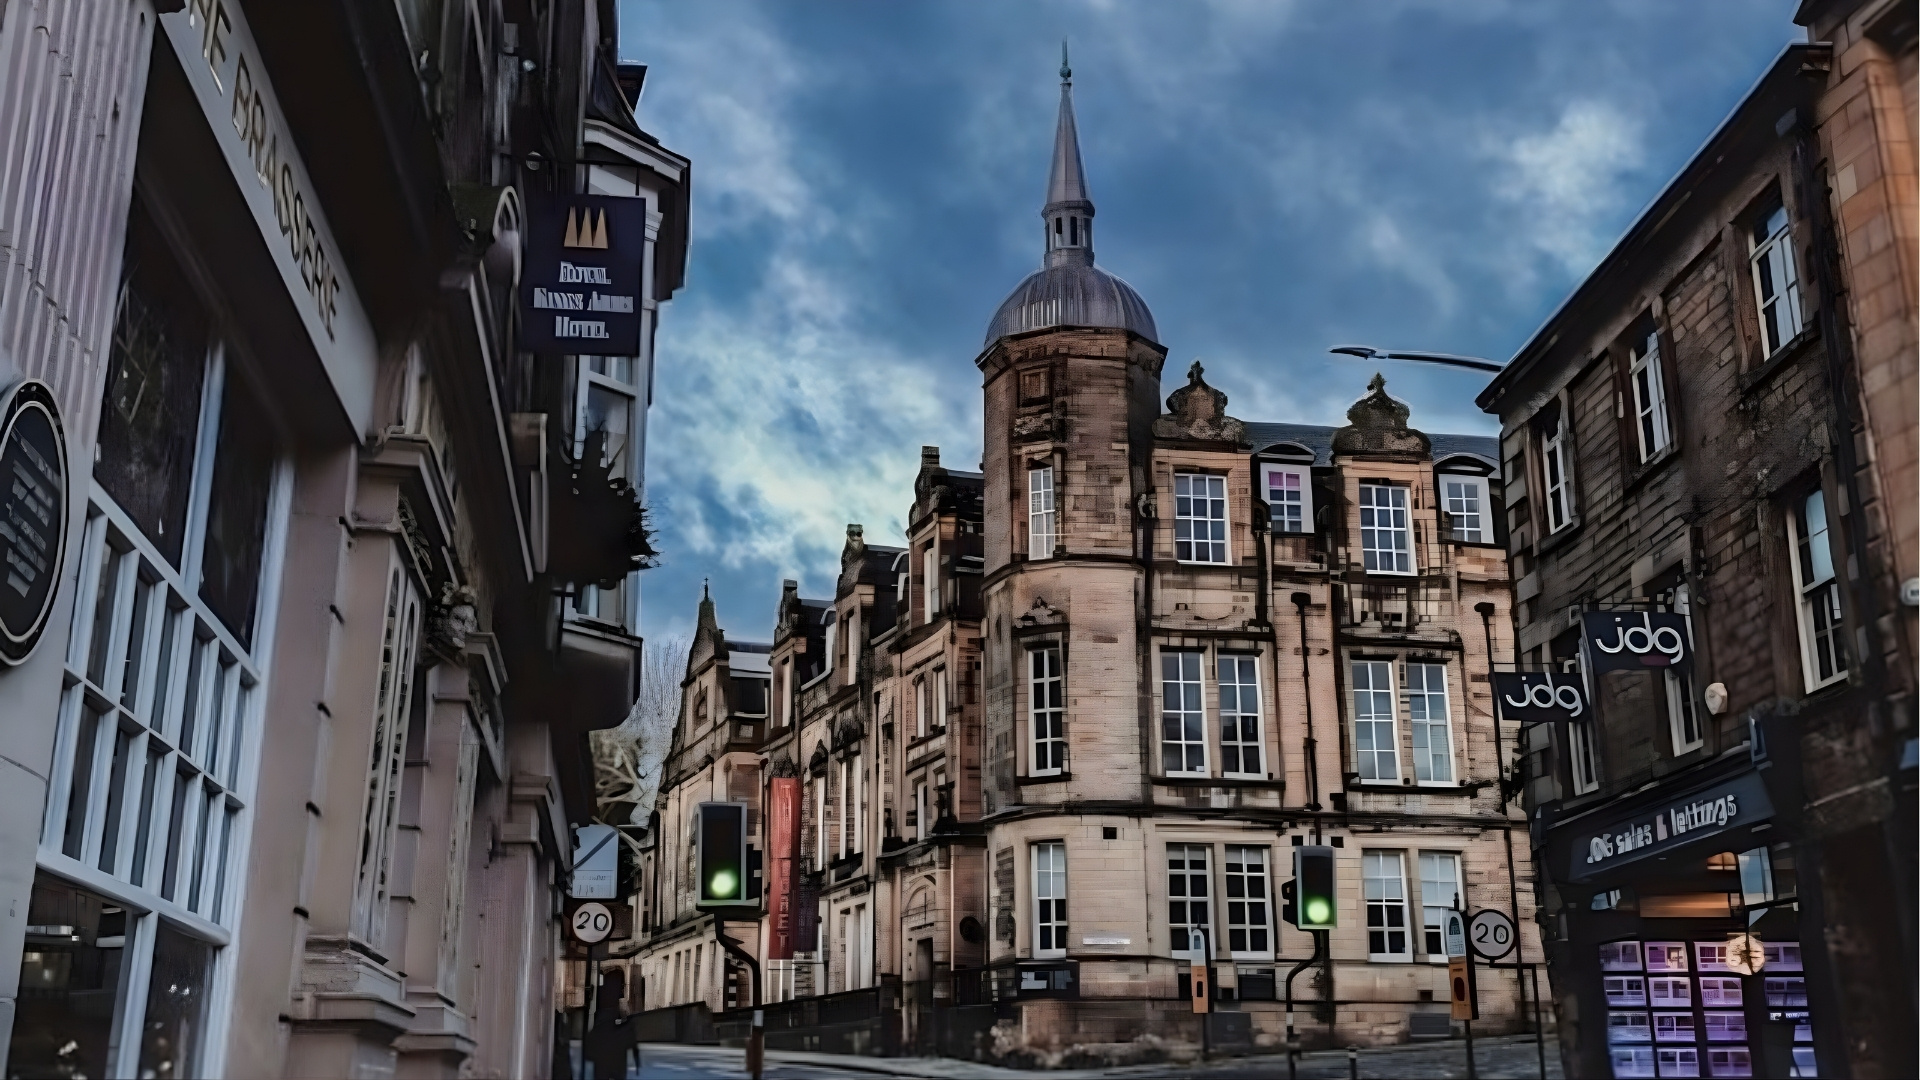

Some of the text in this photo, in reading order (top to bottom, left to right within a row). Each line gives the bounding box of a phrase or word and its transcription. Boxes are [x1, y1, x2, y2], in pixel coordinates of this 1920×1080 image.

[1595, 611, 1684, 665] jdg
[1505, 672, 1584, 718] jdg
[576, 911, 609, 932] 20
[1475, 922, 1510, 945] 20
